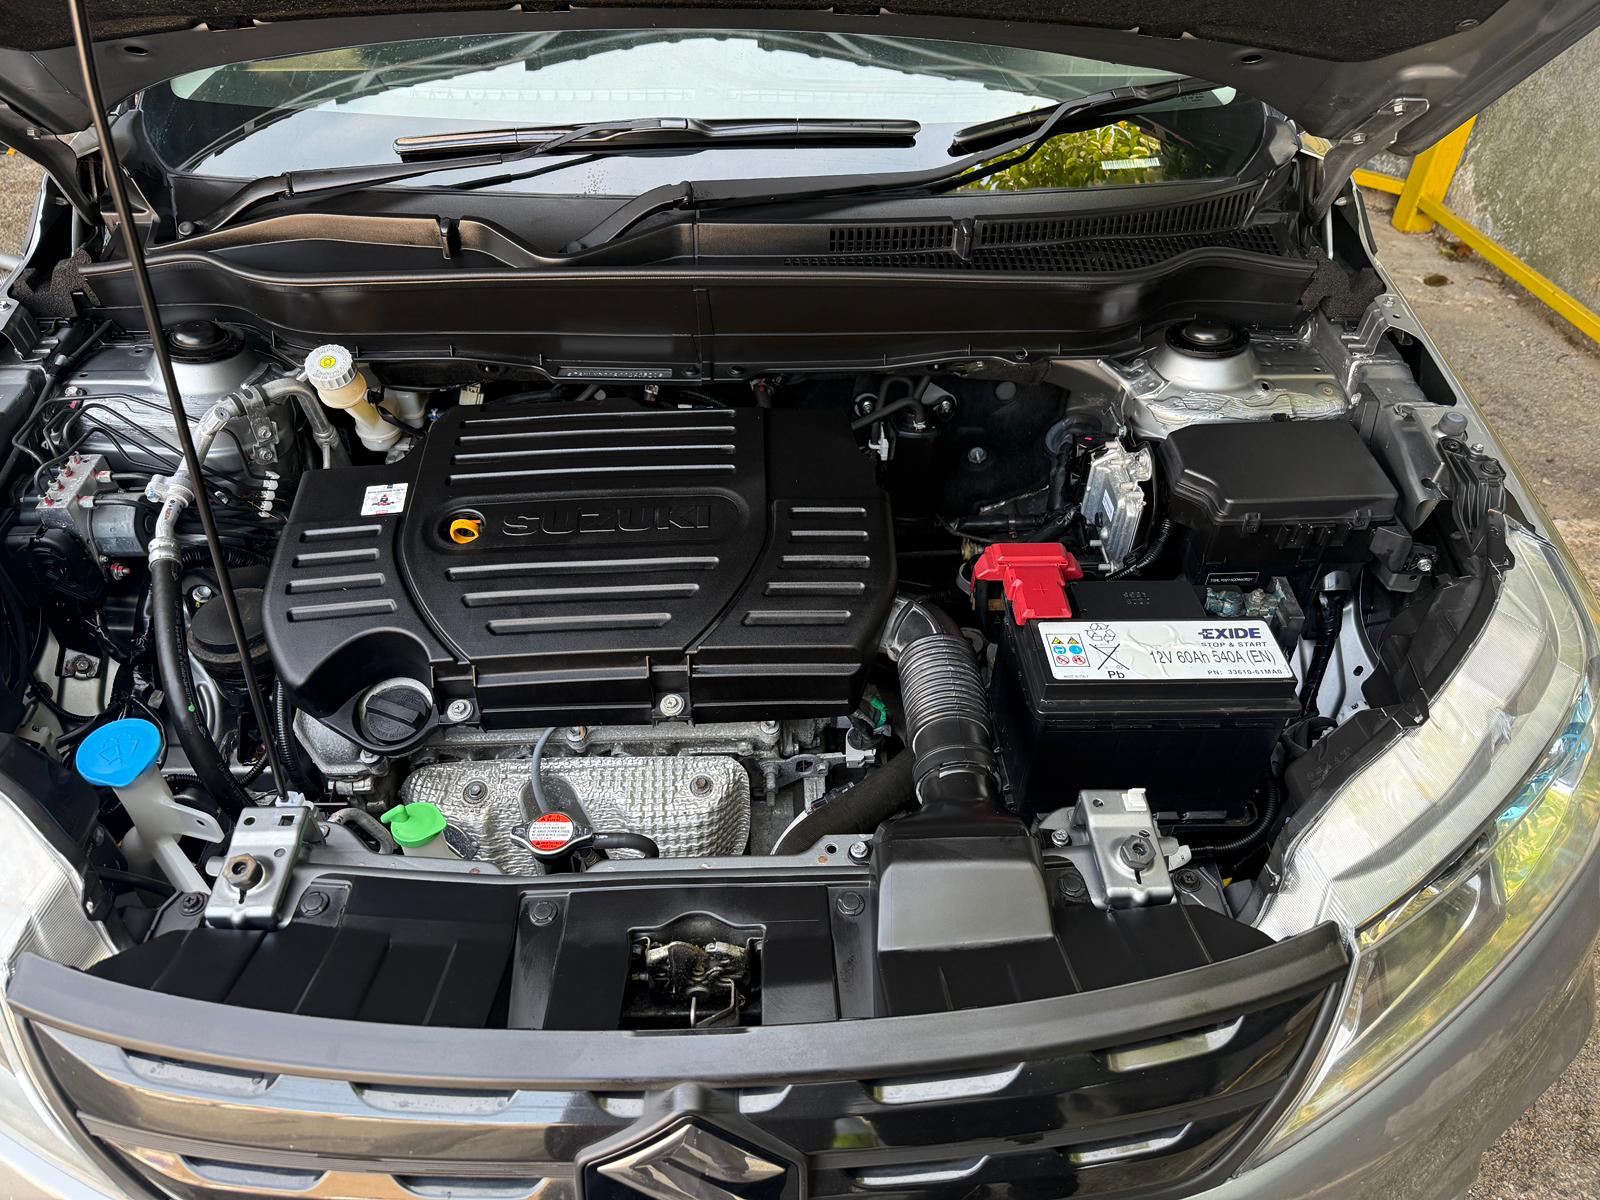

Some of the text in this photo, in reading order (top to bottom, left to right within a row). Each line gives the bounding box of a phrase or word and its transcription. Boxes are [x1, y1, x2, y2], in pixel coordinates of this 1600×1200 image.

[502, 504, 711, 536] SUZUKI
[1198, 627, 1262, 640] EXIDE
[1150, 649, 1277, 667] 12V 60Ah 540A (EN)
[1107, 670, 1126, 679] Pb
